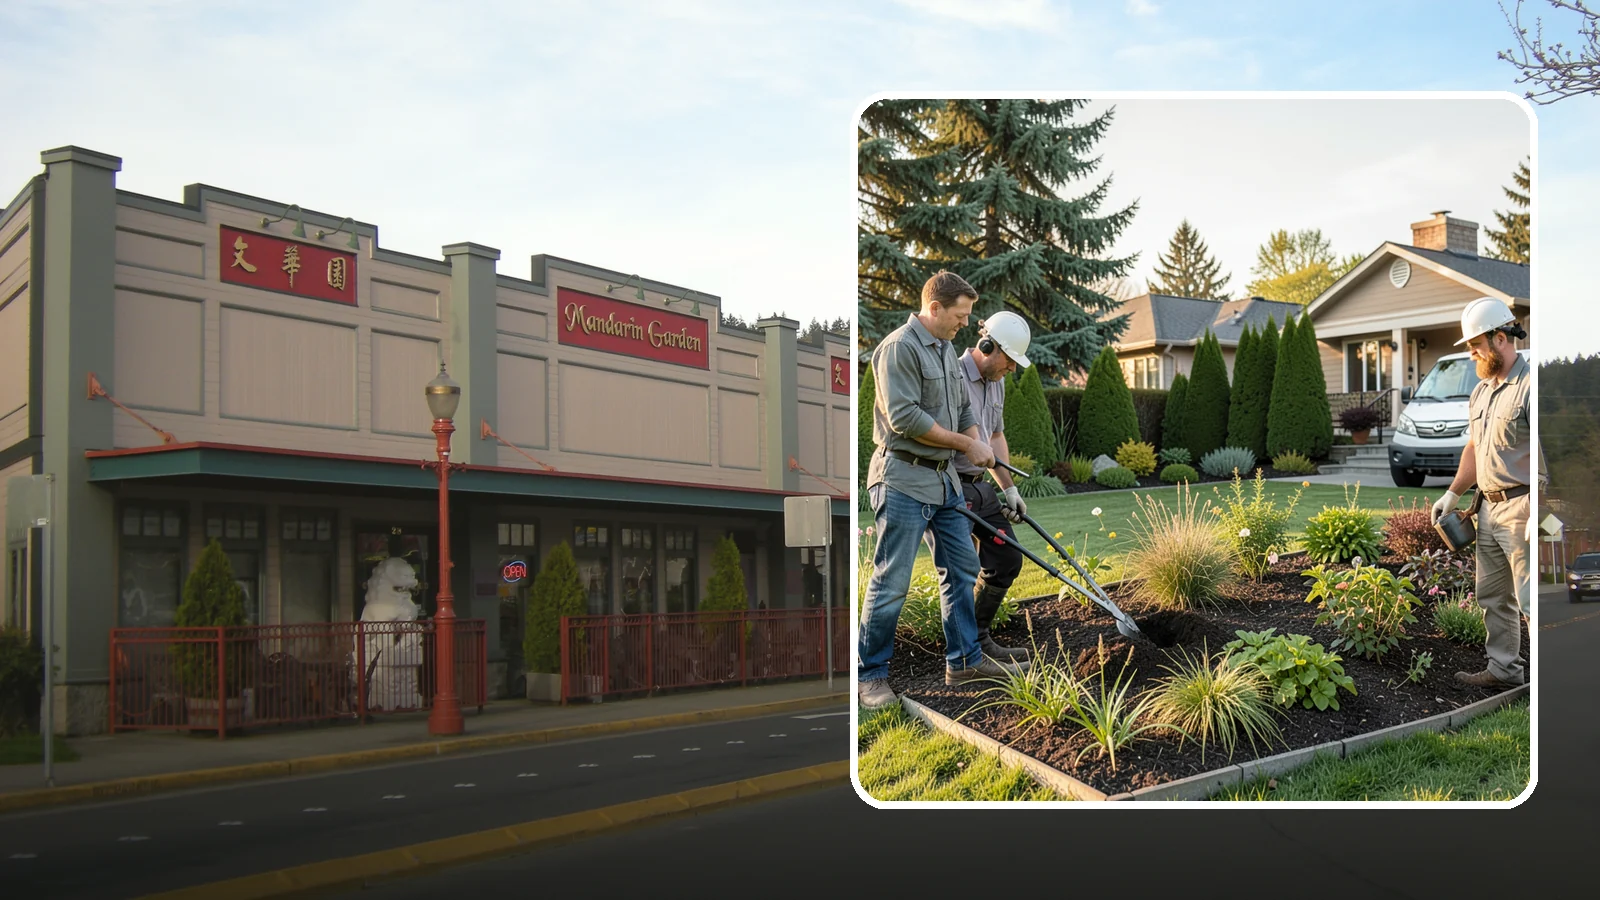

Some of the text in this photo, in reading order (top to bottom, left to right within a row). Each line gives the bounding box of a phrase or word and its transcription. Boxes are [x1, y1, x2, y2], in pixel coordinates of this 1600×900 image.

[231, 236, 346, 291] 文華園
[564, 302, 701, 352] Mandarin Garden
[503, 565, 527, 578] OPEN
